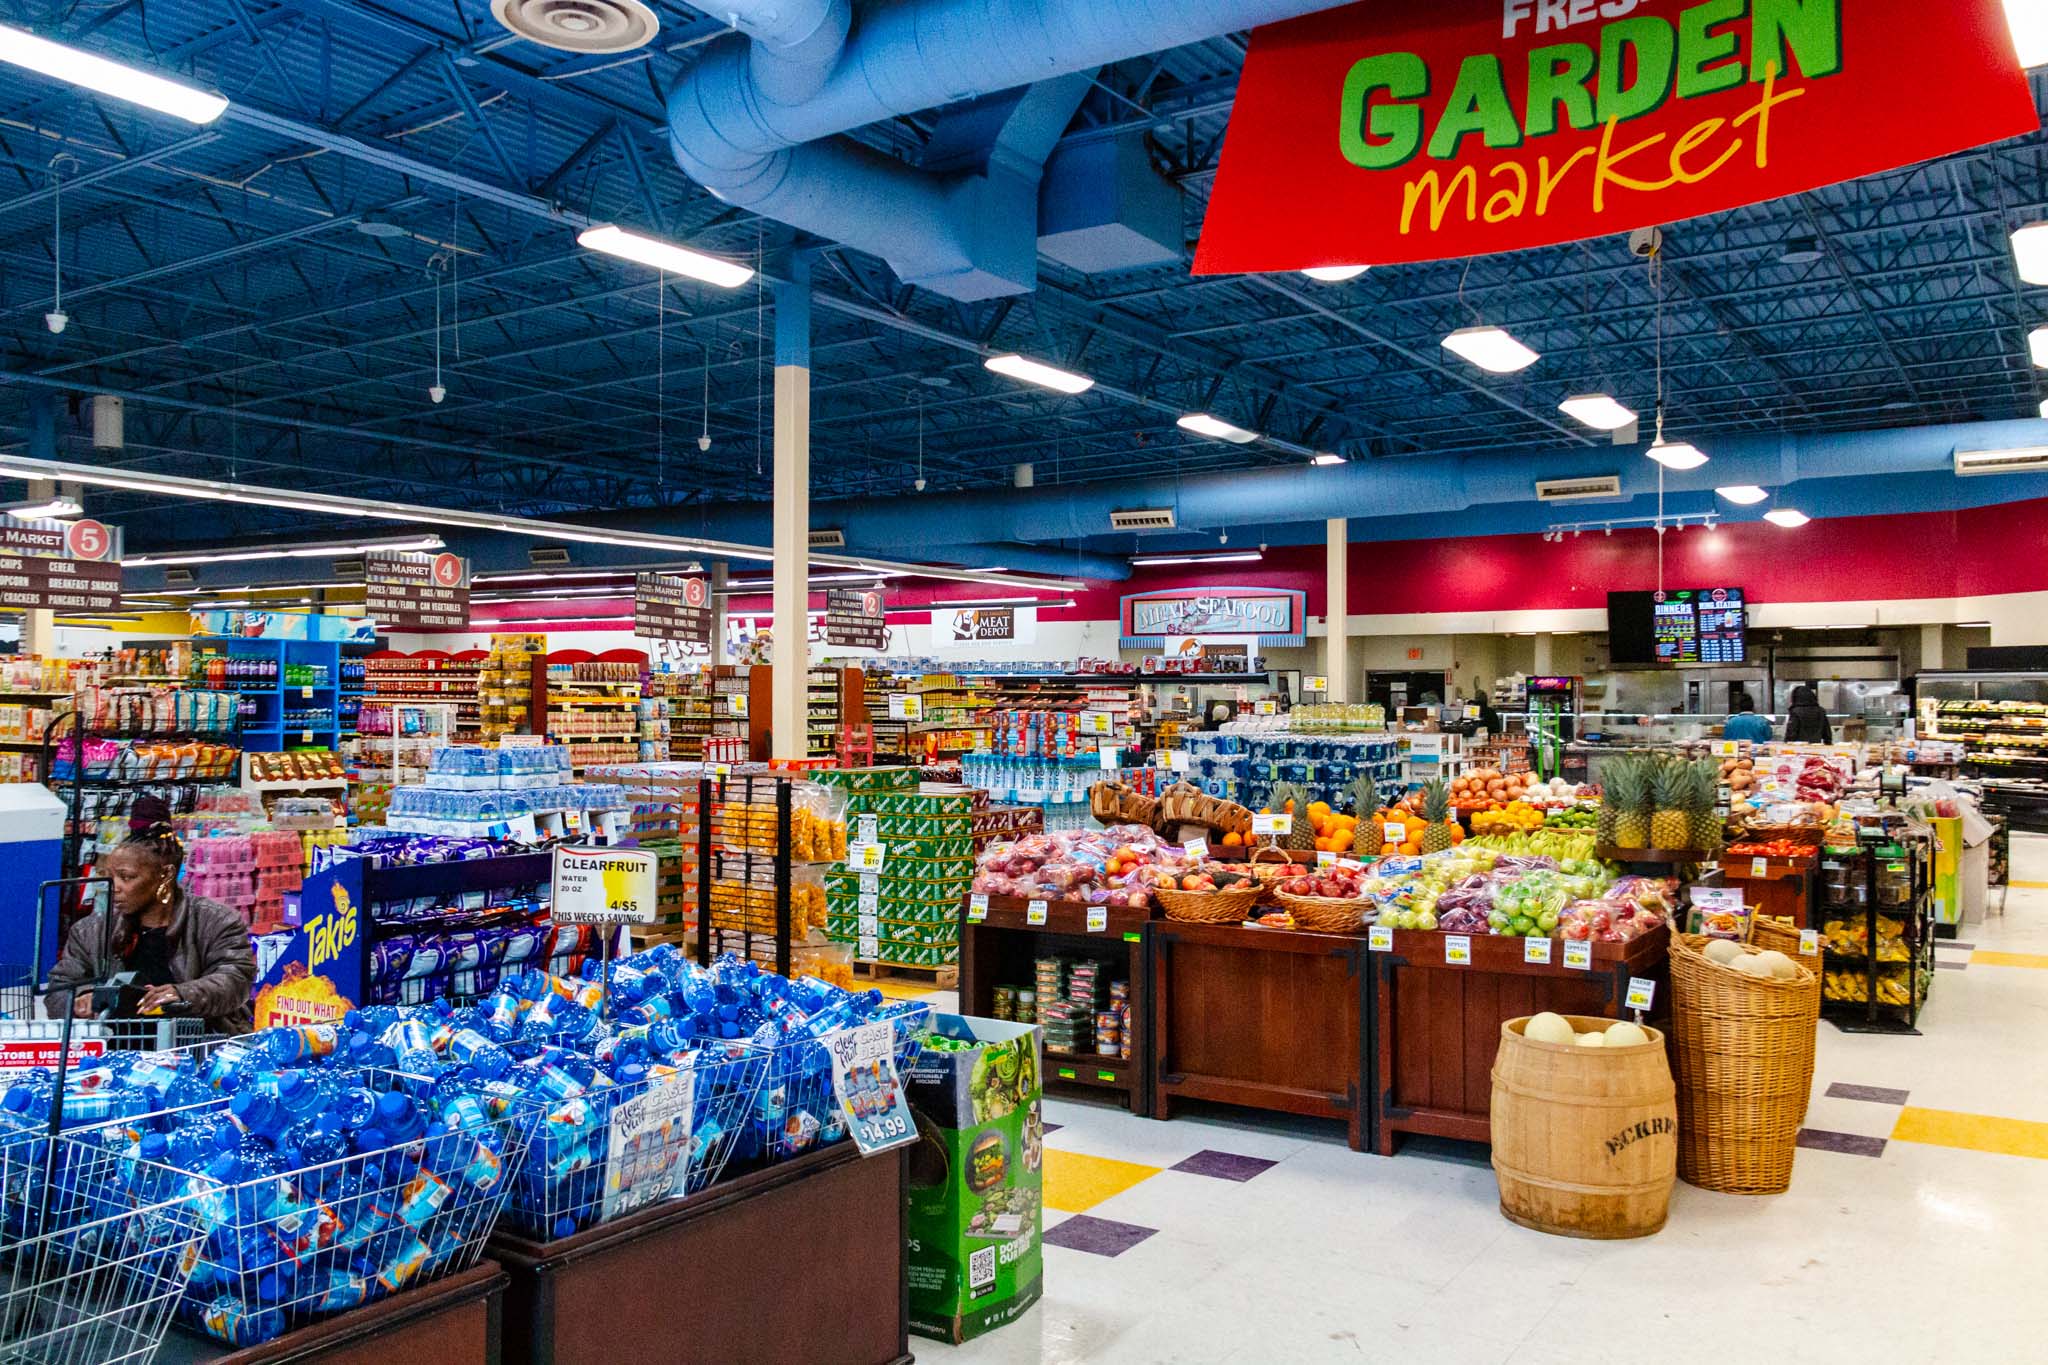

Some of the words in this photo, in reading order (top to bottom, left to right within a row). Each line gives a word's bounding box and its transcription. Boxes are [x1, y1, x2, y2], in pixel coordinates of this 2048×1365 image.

[1339, 0, 1843, 169] GARDEN
[1400, 60, 1805, 235] market
[80, 528, 100, 552] 5
[441, 561, 454, 580] 4
[691, 584, 700, 601] 3
[868, 597, 876, 612] 2
[980, 616, 1011, 628] MEAT
[1195, 597, 1286, 628] SEAFOOD
[980, 627, 1009, 637] DEPOT
[562, 858, 648, 873] CLEARFRUIT
[303, 906, 358, 976] Takis
[276, 995, 294, 1012] FIND
[296, 999, 312, 1015] OUT
[313, 1001, 335, 1019] WHAT
[861, 1115, 908, 1144] $14.99
